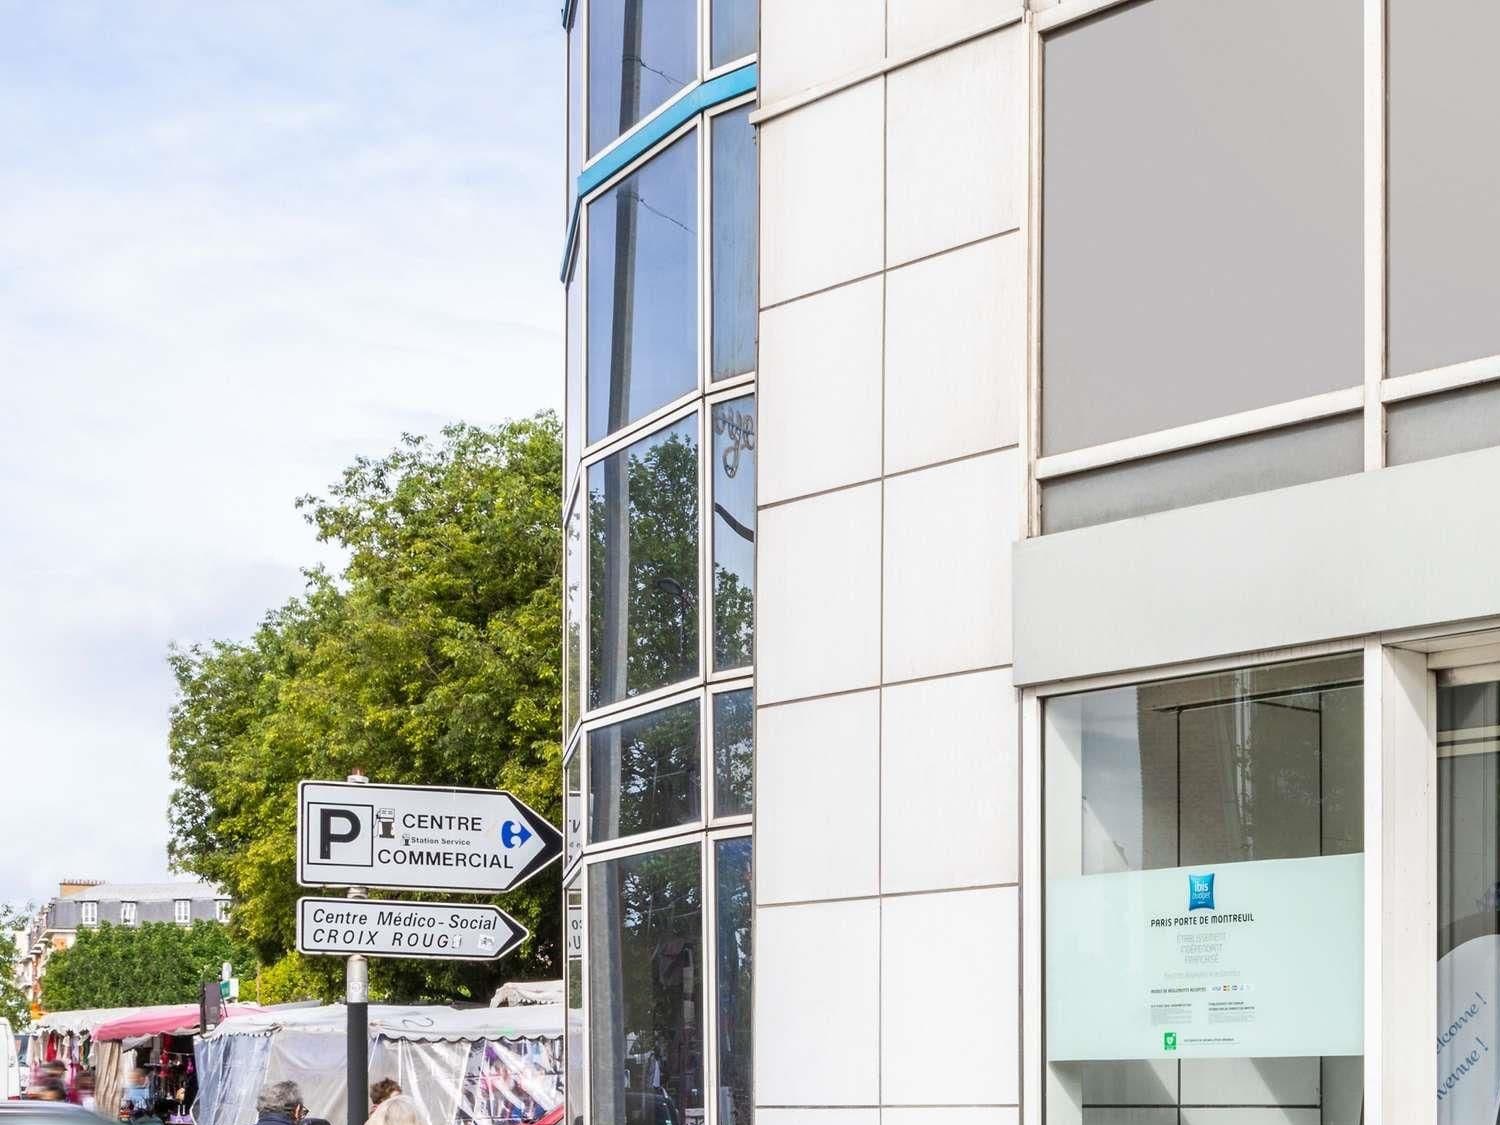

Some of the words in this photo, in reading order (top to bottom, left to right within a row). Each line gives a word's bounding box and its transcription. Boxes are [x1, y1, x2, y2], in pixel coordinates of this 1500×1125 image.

[402, 813, 482, 832] CENTRE
[319, 807, 362, 860] P
[411, 836, 439, 845] Station
[441, 837, 471, 846] Service
[377, 849, 514, 869] COMMERCIAL
[313, 908, 368, 926] Centre
[1150, 918, 1172, 928] PARIS
[1174, 916, 1197, 926] PORTE
[1200, 915, 1209, 925] DE
[1211, 913, 1255, 924] MONTREUIL
[313, 928, 379, 946] CROIX
[391, 931, 462, 949] ROUG
[1437, 1003, 1480, 1056] elcome
